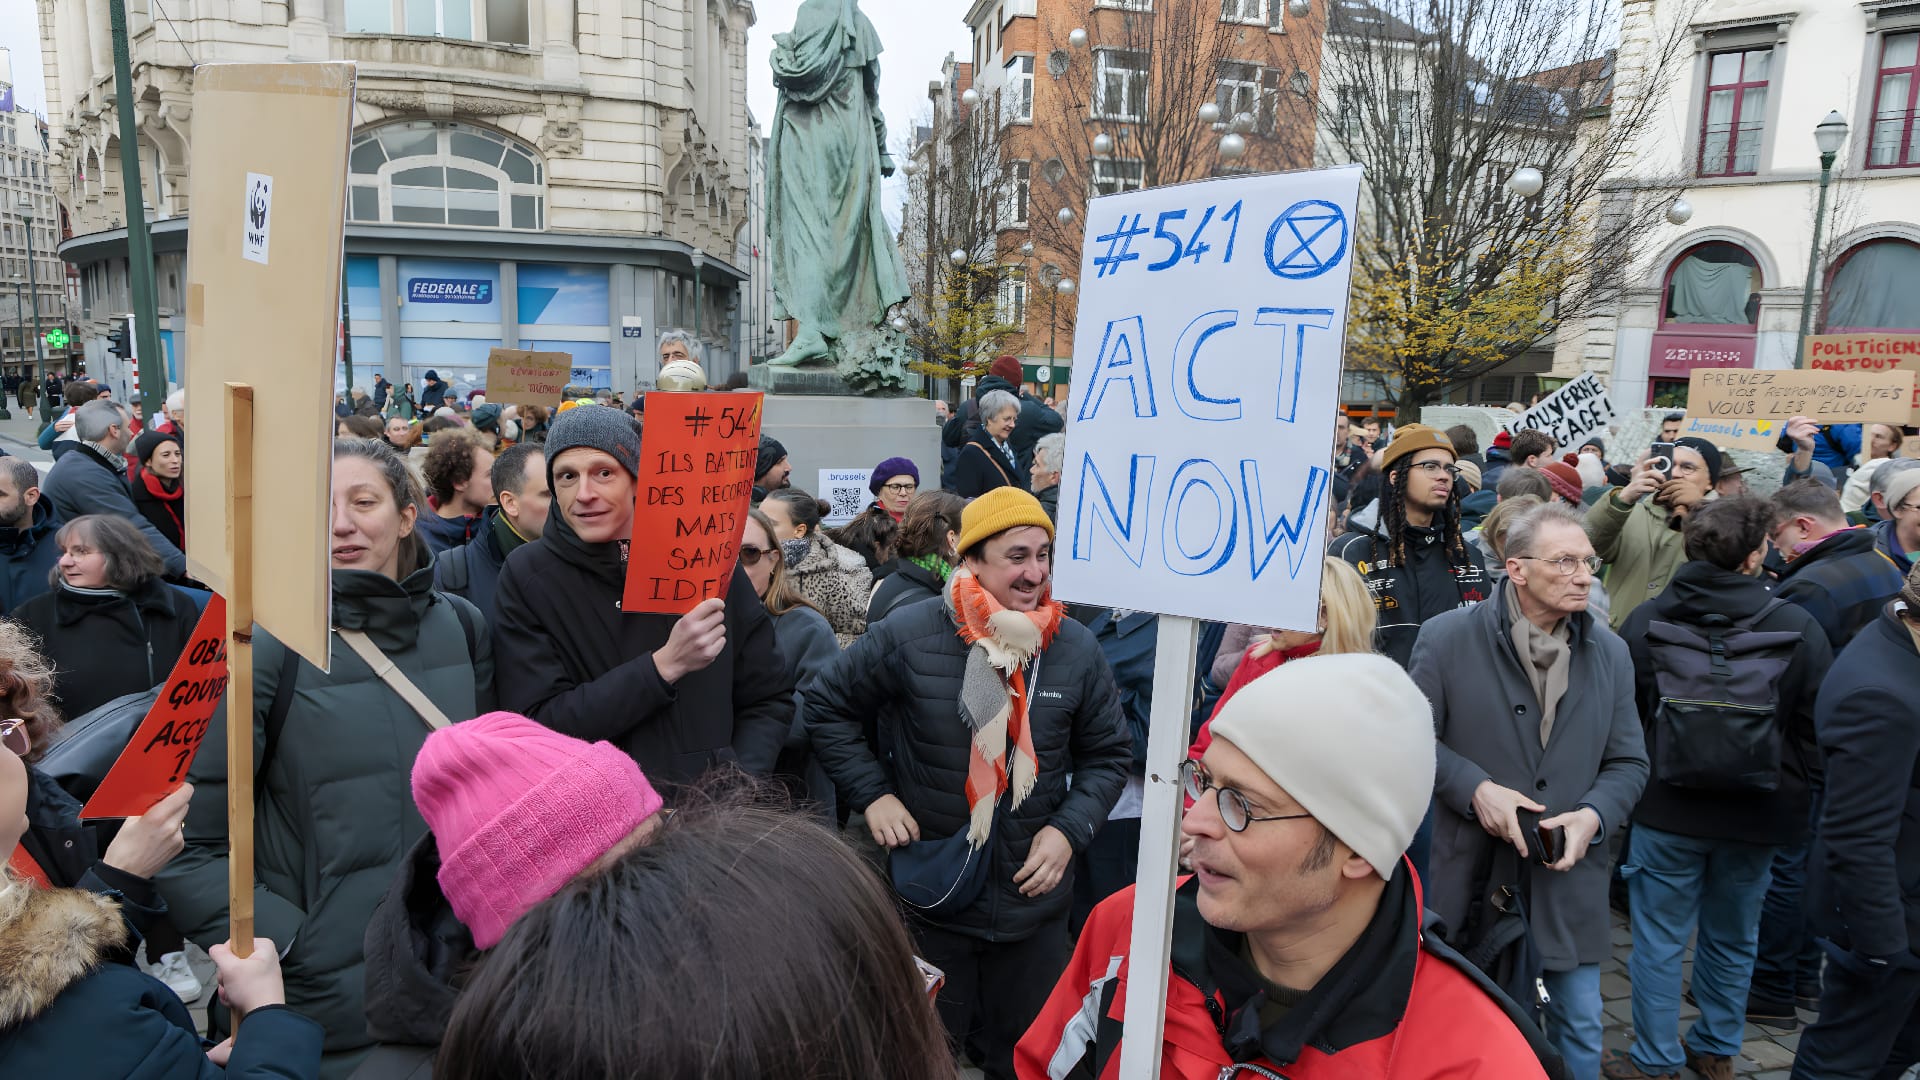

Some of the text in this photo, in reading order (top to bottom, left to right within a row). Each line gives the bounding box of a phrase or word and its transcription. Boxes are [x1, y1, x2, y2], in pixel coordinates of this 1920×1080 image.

[248, 231, 265, 247] WWF
[1094, 200, 1243, 278] #541
[413, 282, 478, 295] FEDERALE
[1077, 307, 1334, 423] ACT
[1811, 358, 1902, 371] PARTOUT
[1703, 373, 1776, 387] PRENEZ
[1708, 400, 1756, 415] VOUS
[1769, 400, 1806, 414] LES
[655, 447, 758, 474] ILS BATTENT
[647, 478, 753, 506] DES RECORDS
[675, 512, 735, 538] MAIS
[1072, 452, 1328, 581] NOW
[667, 541, 733, 570] SANS
[189, 637, 227, 666] OBL
[168, 749, 191, 782] ?
